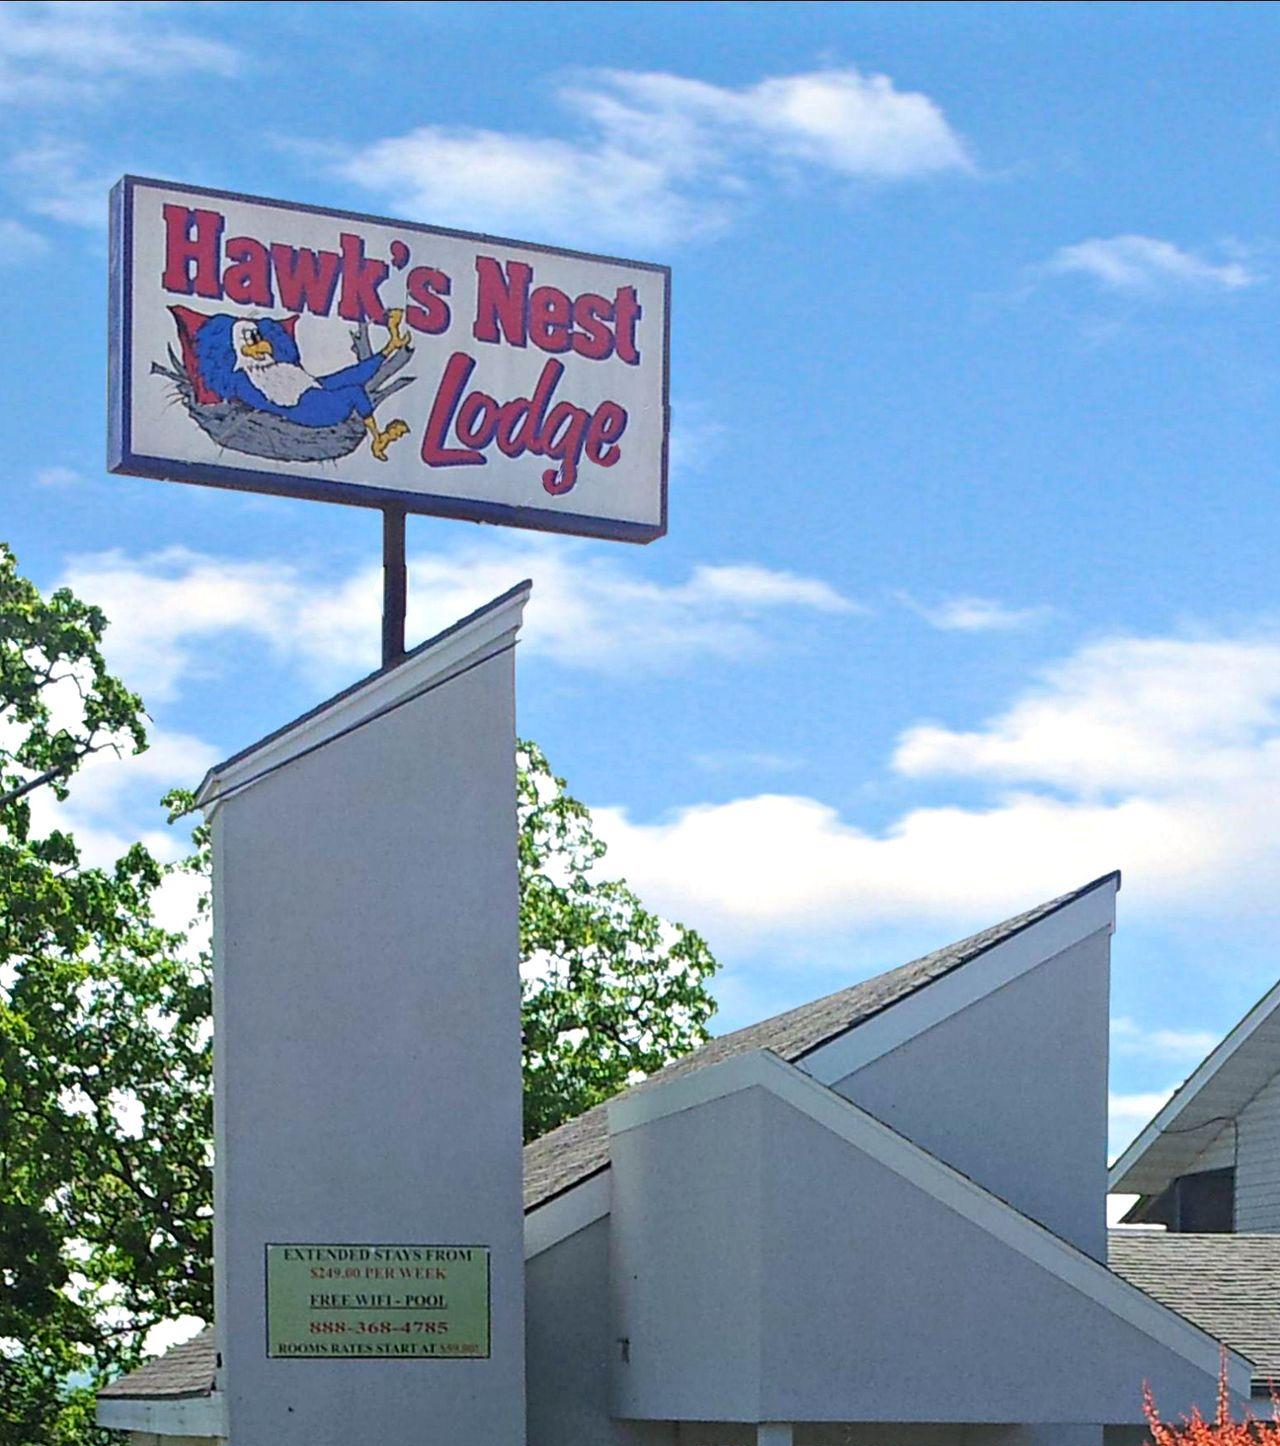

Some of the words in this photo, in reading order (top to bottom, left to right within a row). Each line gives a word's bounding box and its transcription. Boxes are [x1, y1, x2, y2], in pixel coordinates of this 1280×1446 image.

[161, 204, 452, 337] Hawk's
[472, 255, 642, 366] Nest
[419, 351, 629, 497] Lodge
[283, 1248, 370, 1261] EXTENDED
[374, 1249, 422, 1261] STAYS
[425, 1249, 472, 1262] FROM
[364, 1267, 394, 1279] PER
[400, 1267, 447, 1280] WEEK
[310, 1294, 351, 1306] FREE
[354, 1294, 392, 1306] WIFI
[405, 1294, 448, 1307] POOL
[309, 1321, 449, 1334] 888-368-4785
[278, 1343, 328, 1354] ROOMS
[331, 1343, 373, 1354] RATES
[375, 1343, 418, 1354] START
[421, 1343, 436, 1354] AT
